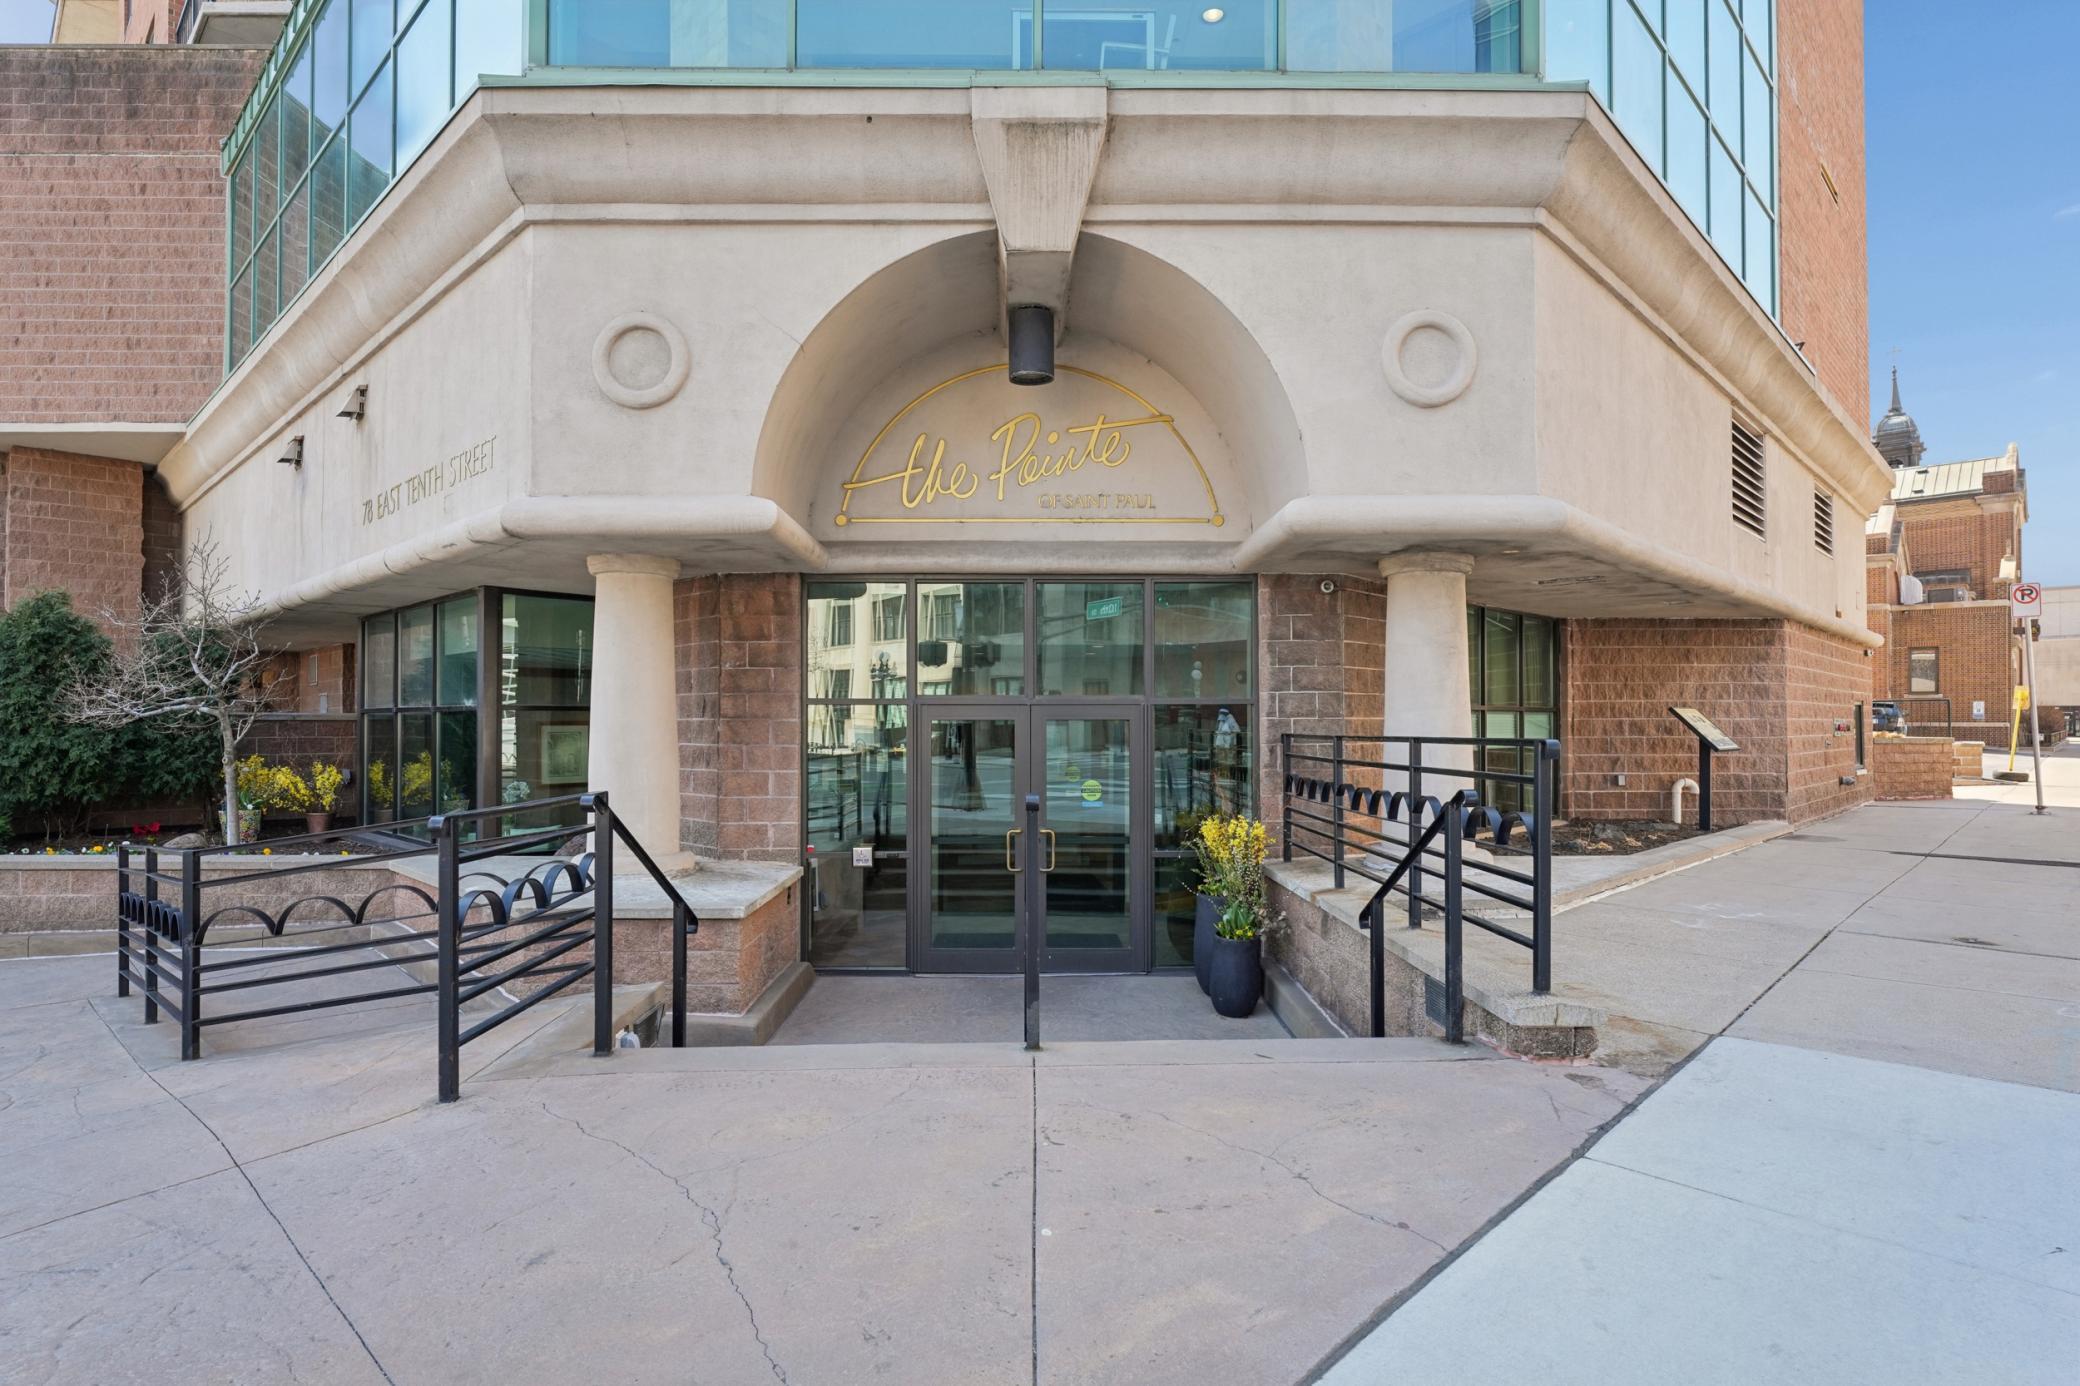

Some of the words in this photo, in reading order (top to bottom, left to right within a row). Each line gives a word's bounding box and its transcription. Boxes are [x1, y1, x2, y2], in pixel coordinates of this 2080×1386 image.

[362, 499, 374, 526] 78
[377, 483, 402, 520] EAST
[405, 462, 444, 506] TENTH
[449, 435, 497, 488] STREET
[843, 433, 979, 509] the
[988, 412, 1174, 500] Pointe
[1038, 494, 1060, 509] OF
[1062, 494, 1109, 509] SAINT
[1115, 494, 1156, 509] PAUL
